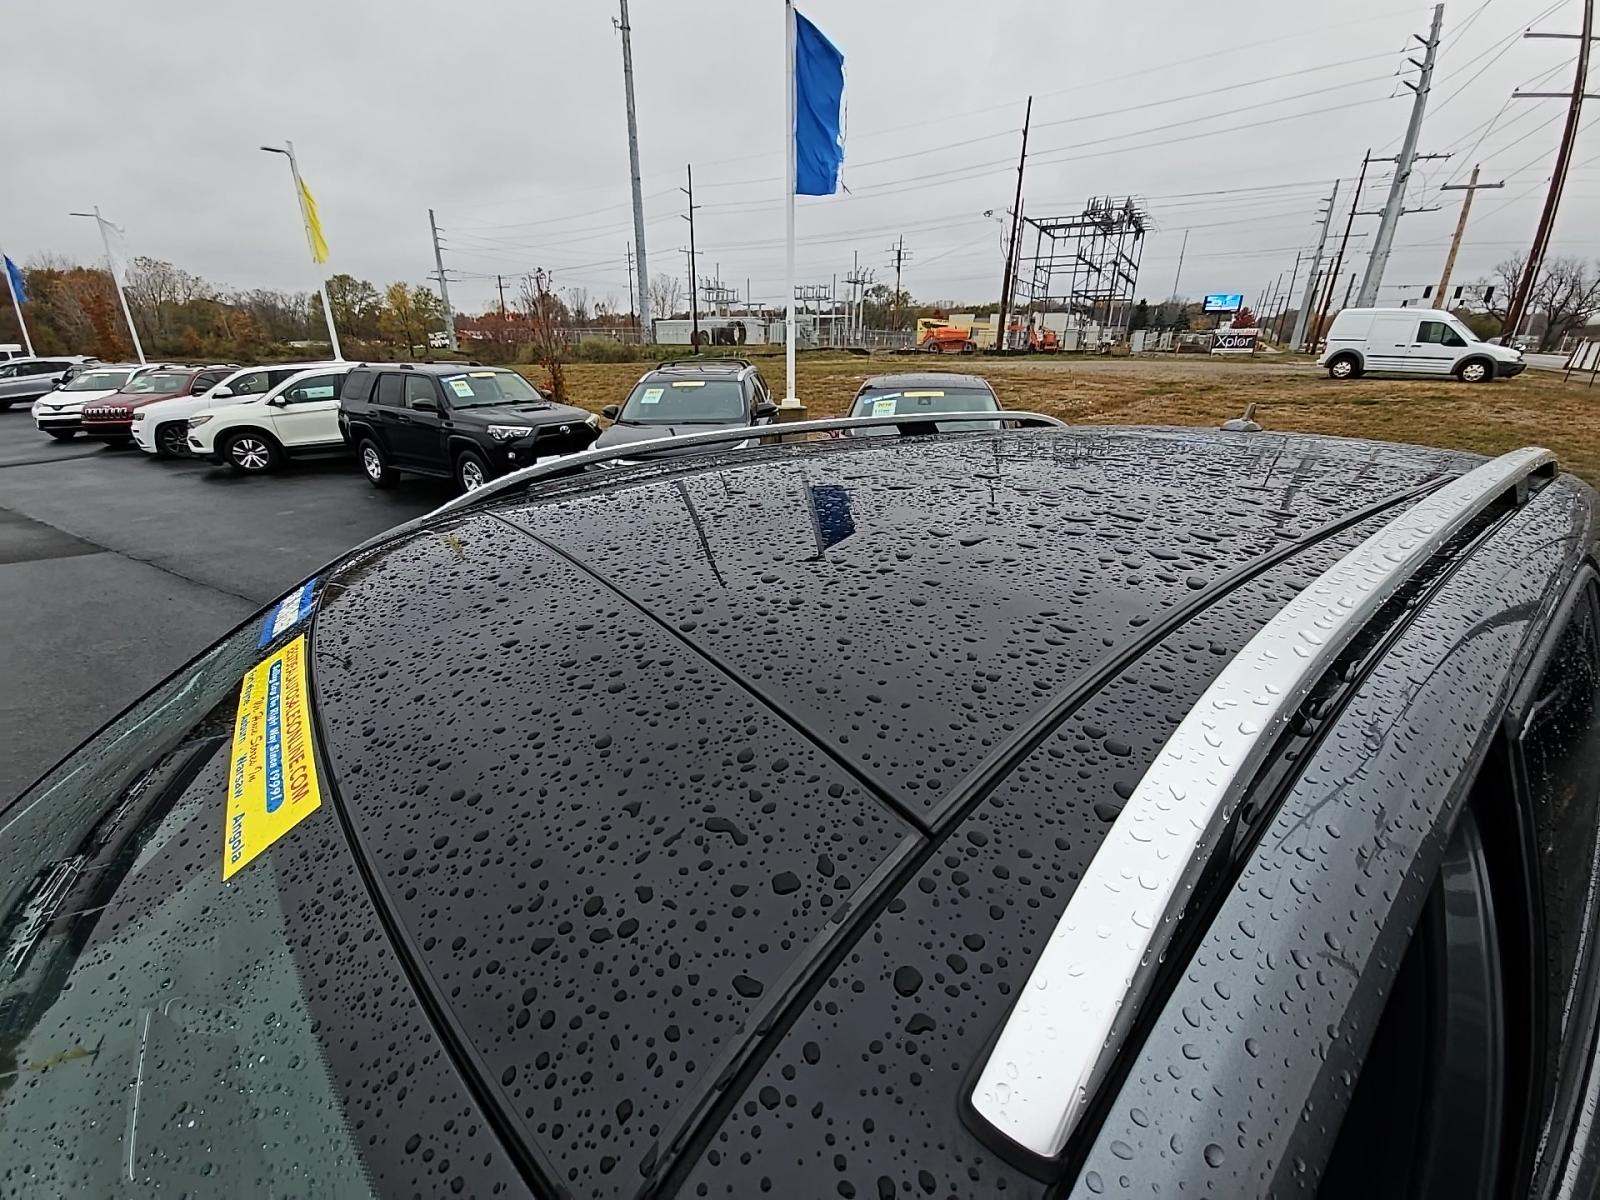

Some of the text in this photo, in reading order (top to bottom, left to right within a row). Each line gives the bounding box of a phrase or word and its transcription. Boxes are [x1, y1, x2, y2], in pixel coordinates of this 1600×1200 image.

[1216, 335, 1253, 348] Xplor
[268, 707, 279, 726] Right
[267, 726, 279, 744] Way
[249, 735, 262, 766] Stores
[269, 744, 279, 768] Since
[234, 753, 247, 798] Warsaw
[269, 769, 281, 801] 1999!
[229, 812, 246, 864] Angola
